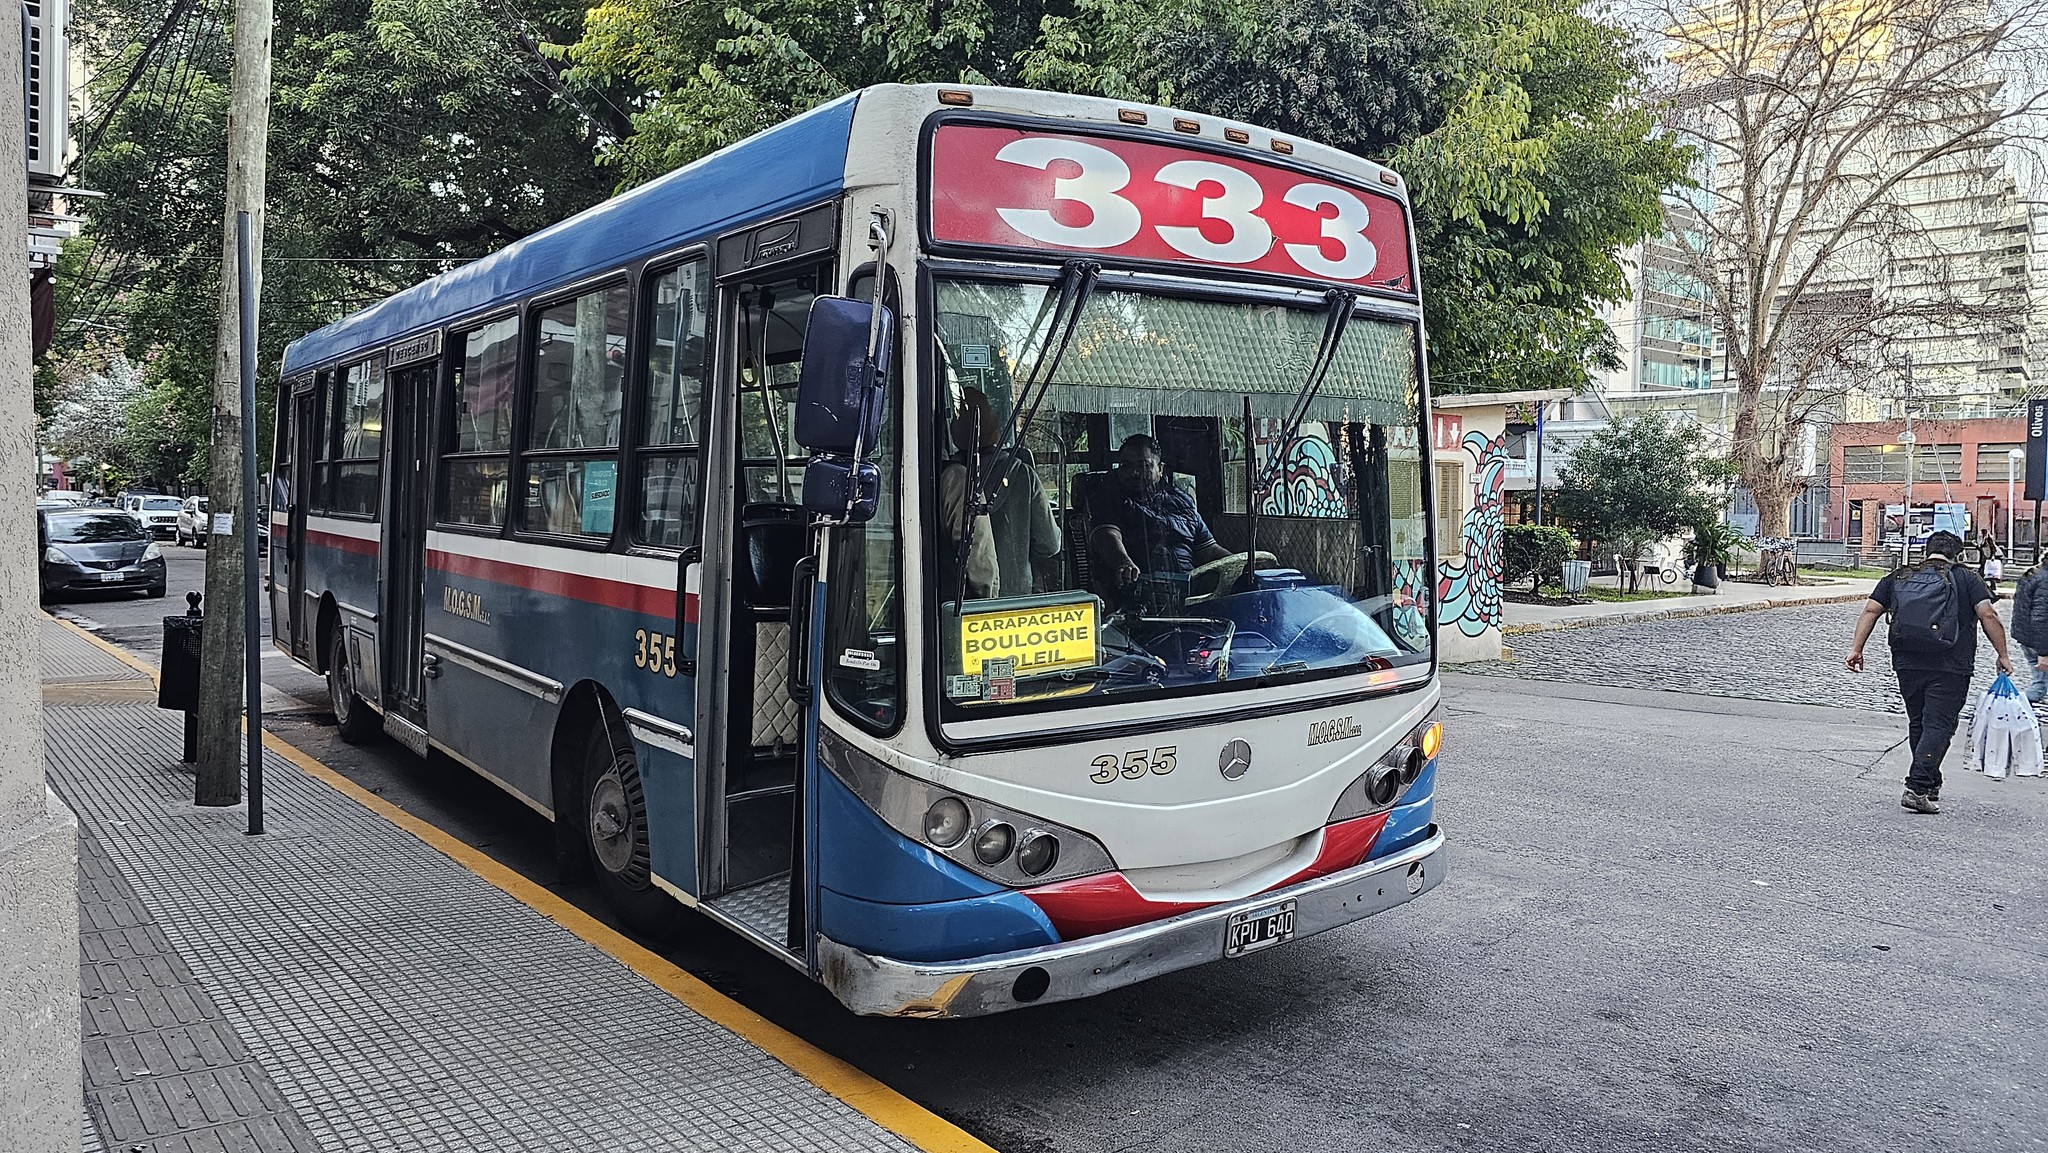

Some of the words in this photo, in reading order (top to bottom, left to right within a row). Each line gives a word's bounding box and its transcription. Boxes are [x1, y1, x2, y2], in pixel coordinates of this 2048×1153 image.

[995, 137, 1377, 280] 333
[2031, 404, 2044, 437] Olivos
[965, 626, 1089, 654] BOULOGNE
[967, 610, 1085, 633] CARAPACHAY
[634, 628, 676, 678] 355
[1089, 745, 1177, 785] 355
[1230, 920, 1260, 948] KPU
[1266, 911, 1294, 939] 640
